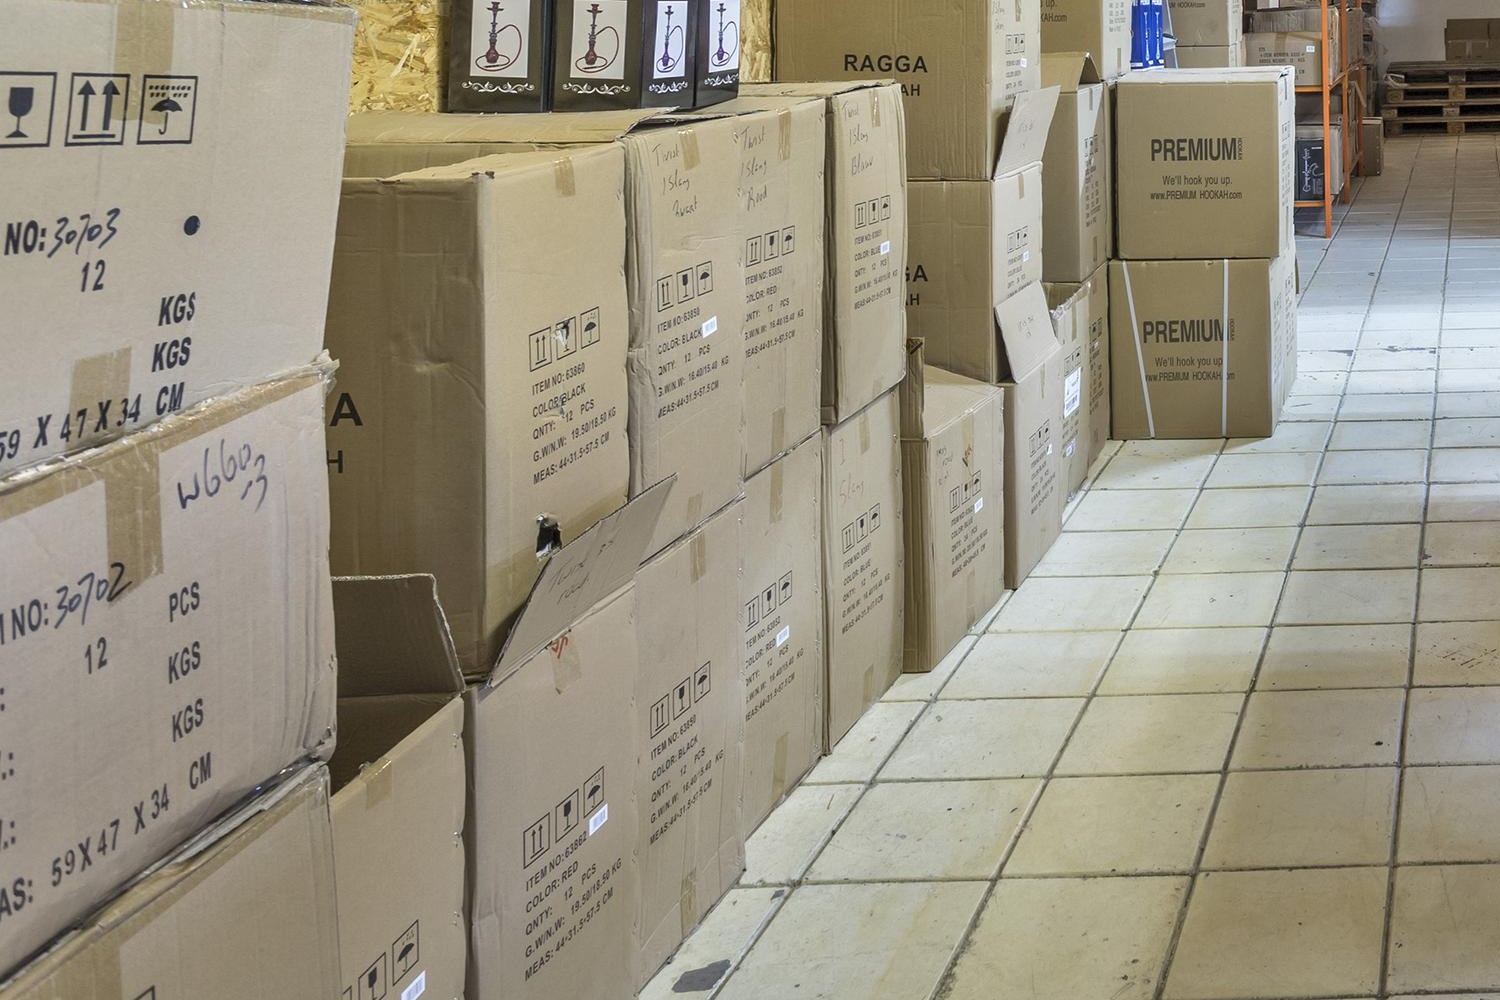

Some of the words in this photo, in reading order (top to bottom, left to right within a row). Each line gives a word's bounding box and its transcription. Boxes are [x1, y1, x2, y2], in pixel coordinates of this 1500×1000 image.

[844, 54, 928, 74] RAGGA
[1151, 138, 1237, 161] PREMIUM
[1162, 175, 1182, 186] We'll
[1184, 175, 1202, 185] hook
[1205, 177, 1218, 187] you
[1221, 176, 1233, 187] up.
[4, 218, 46, 256] NO:
[81, 260, 106, 292] 12
[158, 293, 196, 326] KGS
[657, 318, 673, 334] ITEM
[673, 314, 684, 328] NO:
[657, 337, 680, 355] COLOR:
[682, 329, 703, 345] BLACK
[1143, 319, 1229, 343] PREMIUM
[152, 337, 192, 373] KGS
[684, 352, 691, 363] 12
[698, 344, 711, 357] PCS
[720, 356, 729, 366] KG
[1155, 357, 1174, 367] We'll
[1176, 356, 1195, 367] hook
[1197, 358, 1211, 368] you
[532, 380, 550, 396] ITEM
[551, 373, 564, 387] NO:
[565, 362, 585, 381] 63860
[33, 413, 52, 449] X
[60, 408, 88, 443] 47
[94, 399, 112, 433] X
[119, 393, 142, 425] 34
[155, 383, 186, 416] CM
[532, 420, 556, 440] QNTY:
[565, 410, 573, 423] 12
[581, 399, 595, 415] PCS
[608, 406, 617, 419] KG
[533, 465, 558, 486] MEAS:
[600, 431, 610, 446] CM
[10, 601, 50, 640] NO:
[84, 637, 109, 675] 12
[168, 581, 201, 624] PCS
[166, 641, 202, 686] KGS
[171, 698, 204, 743] KGS
[650, 741, 666, 760] ITEM
[667, 731, 679, 747] NO:
[651, 755, 678, 782] COLOR:
[678, 735, 698, 759] BLACK
[715, 749, 723, 763] KG
[651, 780, 672, 802] QNTY:
[680, 767, 687, 778] 12
[694, 748, 705, 764] PCS
[51, 848, 75, 887] 59
[97, 818, 119, 855] 47
[150, 784, 170, 820] 34
[188, 752, 213, 791] CM
[525, 869, 548, 891] ITEM
[550, 856, 564, 878] NO:
[564, 832, 588, 859] 63862
[611, 857, 622, 878] KG
[525, 878, 560, 913] COLOR:
[561, 861, 578, 886] RED
[525, 906, 553, 936] QNTY:
[563, 889, 573, 904] 12
[581, 863, 596, 887] PCS
[525, 947, 554, 982] MEAS:
[602, 887, 613, 908] CM
